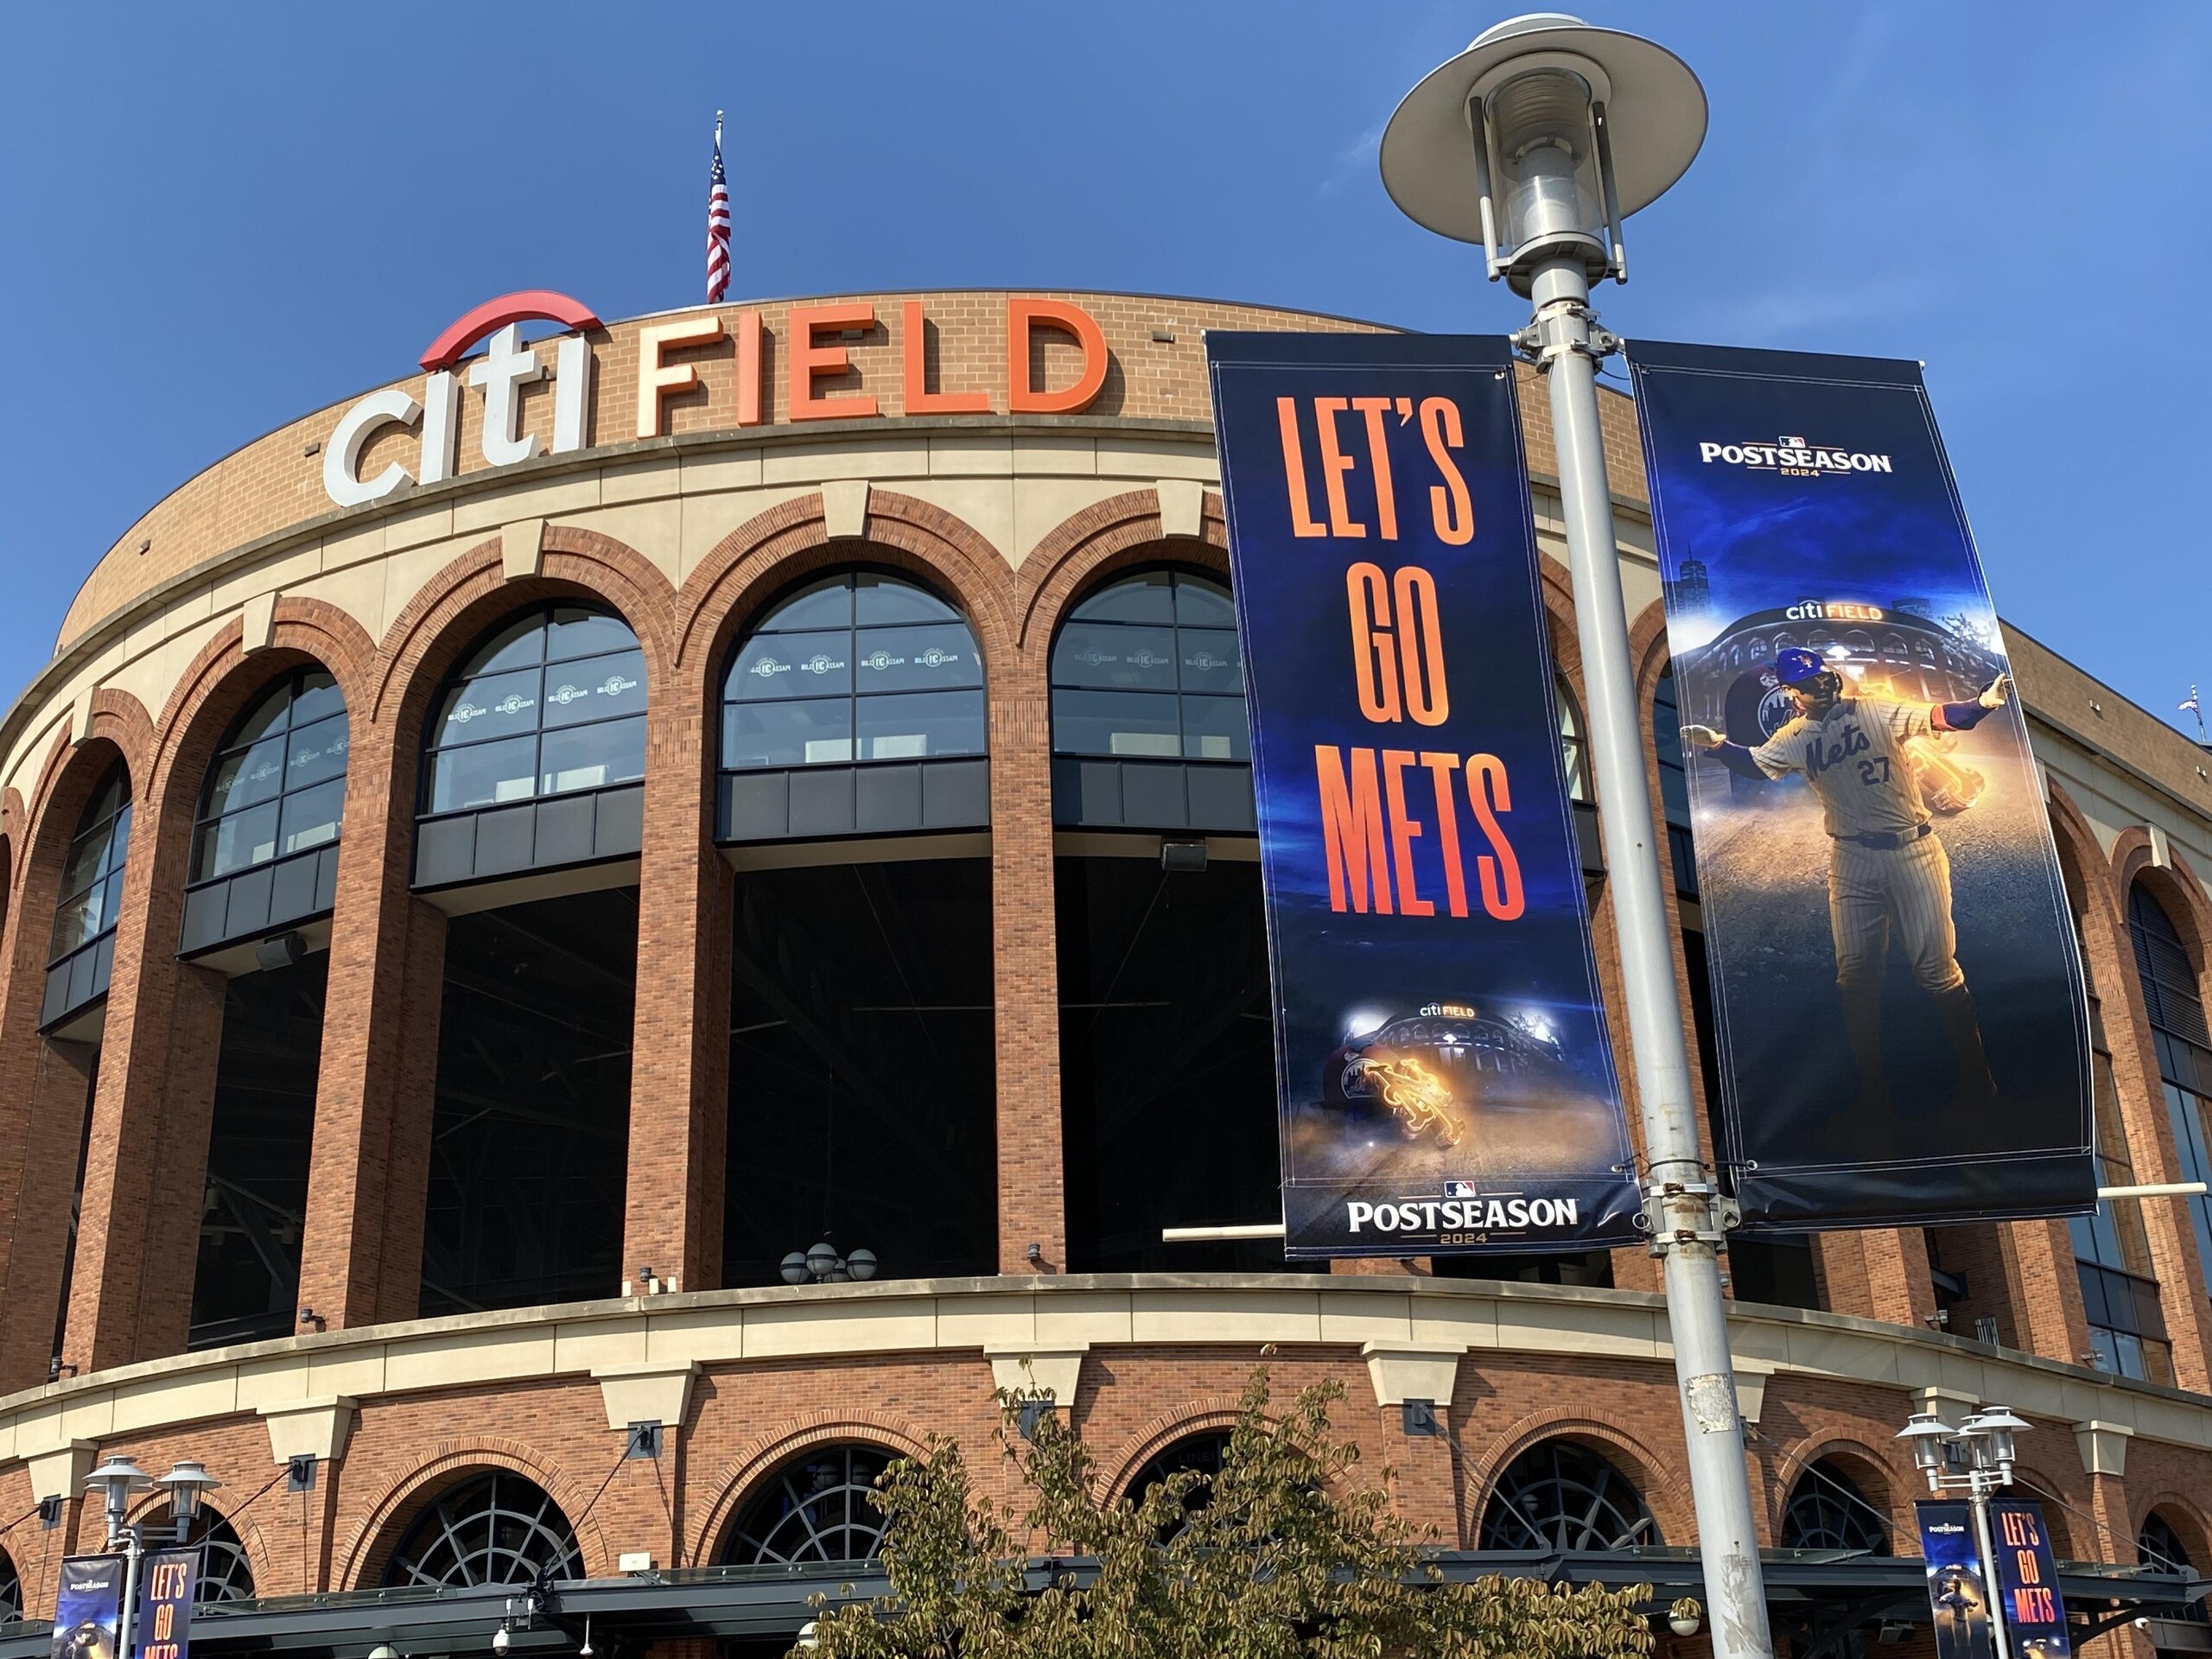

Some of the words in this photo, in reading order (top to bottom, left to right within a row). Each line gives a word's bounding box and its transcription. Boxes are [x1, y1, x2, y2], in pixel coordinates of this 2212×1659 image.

[322, 322, 591, 507] citi
[637, 299, 1109, 439] FIELD
[1276, 397, 1474, 546] LET'S
[1699, 442, 1893, 473] POSTSEASON
[1780, 467, 1821, 477] 2024
[1786, 602, 1823, 620] citi
[1826, 605, 1883, 620] FIELD
[1345, 562, 1449, 727] GO
[1806, 724, 1871, 781] Mets
[1857, 756, 1890, 785] 27
[1314, 745, 1525, 921] METS
[1420, 1005, 1441, 1016] citi
[1442, 1006, 1475, 1017] FIELD
[1346, 1198, 1579, 1233] POSTSEASON
[1440, 1233, 1487, 1244] 2024
[150, 1562, 188, 1601] LET'S
[2017, 1549, 2039, 1585] GO
[154, 1604, 174, 1641] GO
[2013, 1587, 2055, 1624] METS
